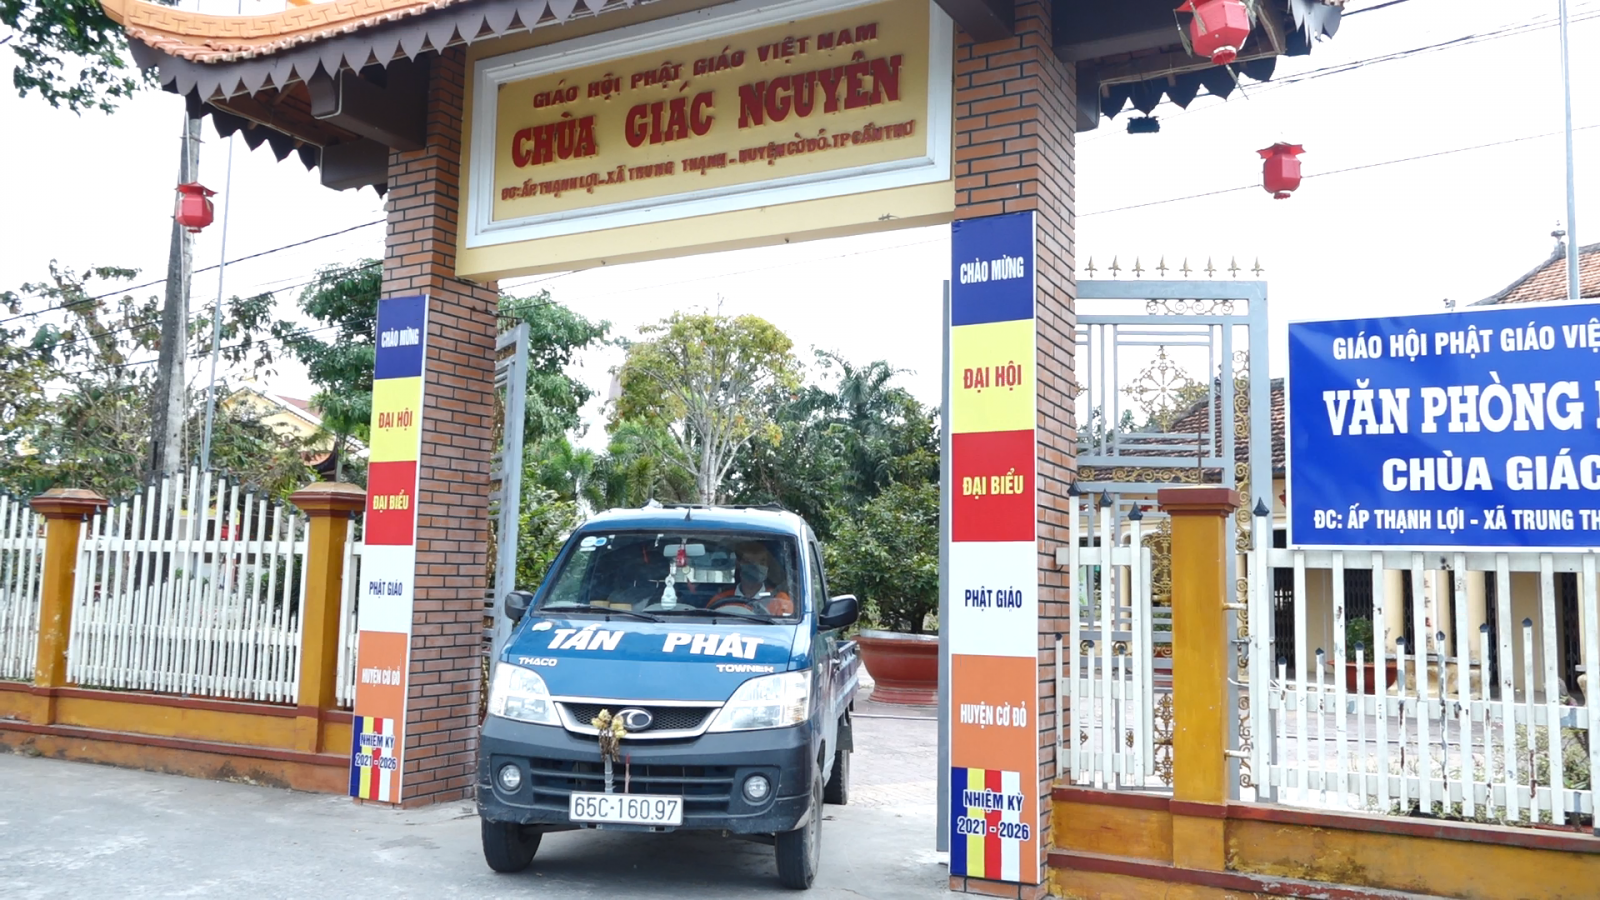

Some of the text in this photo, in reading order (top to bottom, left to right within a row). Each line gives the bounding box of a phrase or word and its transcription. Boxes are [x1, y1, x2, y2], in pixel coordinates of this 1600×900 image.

[533, 22, 878, 109] GIÁO HỘI PHẬT GIÁO VIỆT NAM
[512, 49, 902, 168] CHÙA GIÁC NGUYÊN
[538, 176, 579, 198] THẠNH
[605, 164, 626, 185] XÃ
[628, 161, 675, 182] TRUNG
[681, 152, 727, 175] THẠNH
[738, 141, 785, 166] HUYỆN
[959, 253, 1024, 285] CHÀO MỪNG
[1333, 331, 1382, 360] GIÁO
[1390, 328, 1427, 362] HỘI
[1435, 325, 1493, 359] PHẬT
[1500, 321, 1555, 352] GIÁO
[963, 360, 1022, 393] ĐẠI HỘI
[1323, 378, 1410, 436] VĂN
[1421, 371, 1585, 434] PHÒNG
[378, 407, 413, 432] ĐẠI HỘI
[962, 467, 1024, 499] ĐẠI BIỂU
[1382, 447, 1600, 491] CHÙA GIÁC
[372, 488, 410, 513] ĐẠI BIỂU
[1314, 509, 1343, 529] ĐC:
[1347, 503, 1370, 529] ẤP
[1374, 509, 1432, 534] THẠNH
[1437, 507, 1465, 534] LỢI
[1483, 505, 1508, 530] XÃ
[1511, 509, 1575, 531] TRUNG
[369, 579, 403, 599] PHẬT GIÁO
[964, 586, 1023, 612] PHẬT GIÁO
[662, 632, 764, 660] PHÁT
[518, 657, 558, 667] THACO
[716, 664, 774, 673] TOWNER
[960, 701, 1027, 729] HUYỆN CỜ ĐỎ
[360, 732, 383, 750] NHIỆM
[355, 754, 373, 767] 2021
[379, 756, 397, 771] 2026
[574, 796, 678, 821] 65C-160.97
[963, 788, 1024, 814] NHIỆM KỲ
[957, 817, 987, 836] 2021
[999, 821, 1030, 840] 2026
